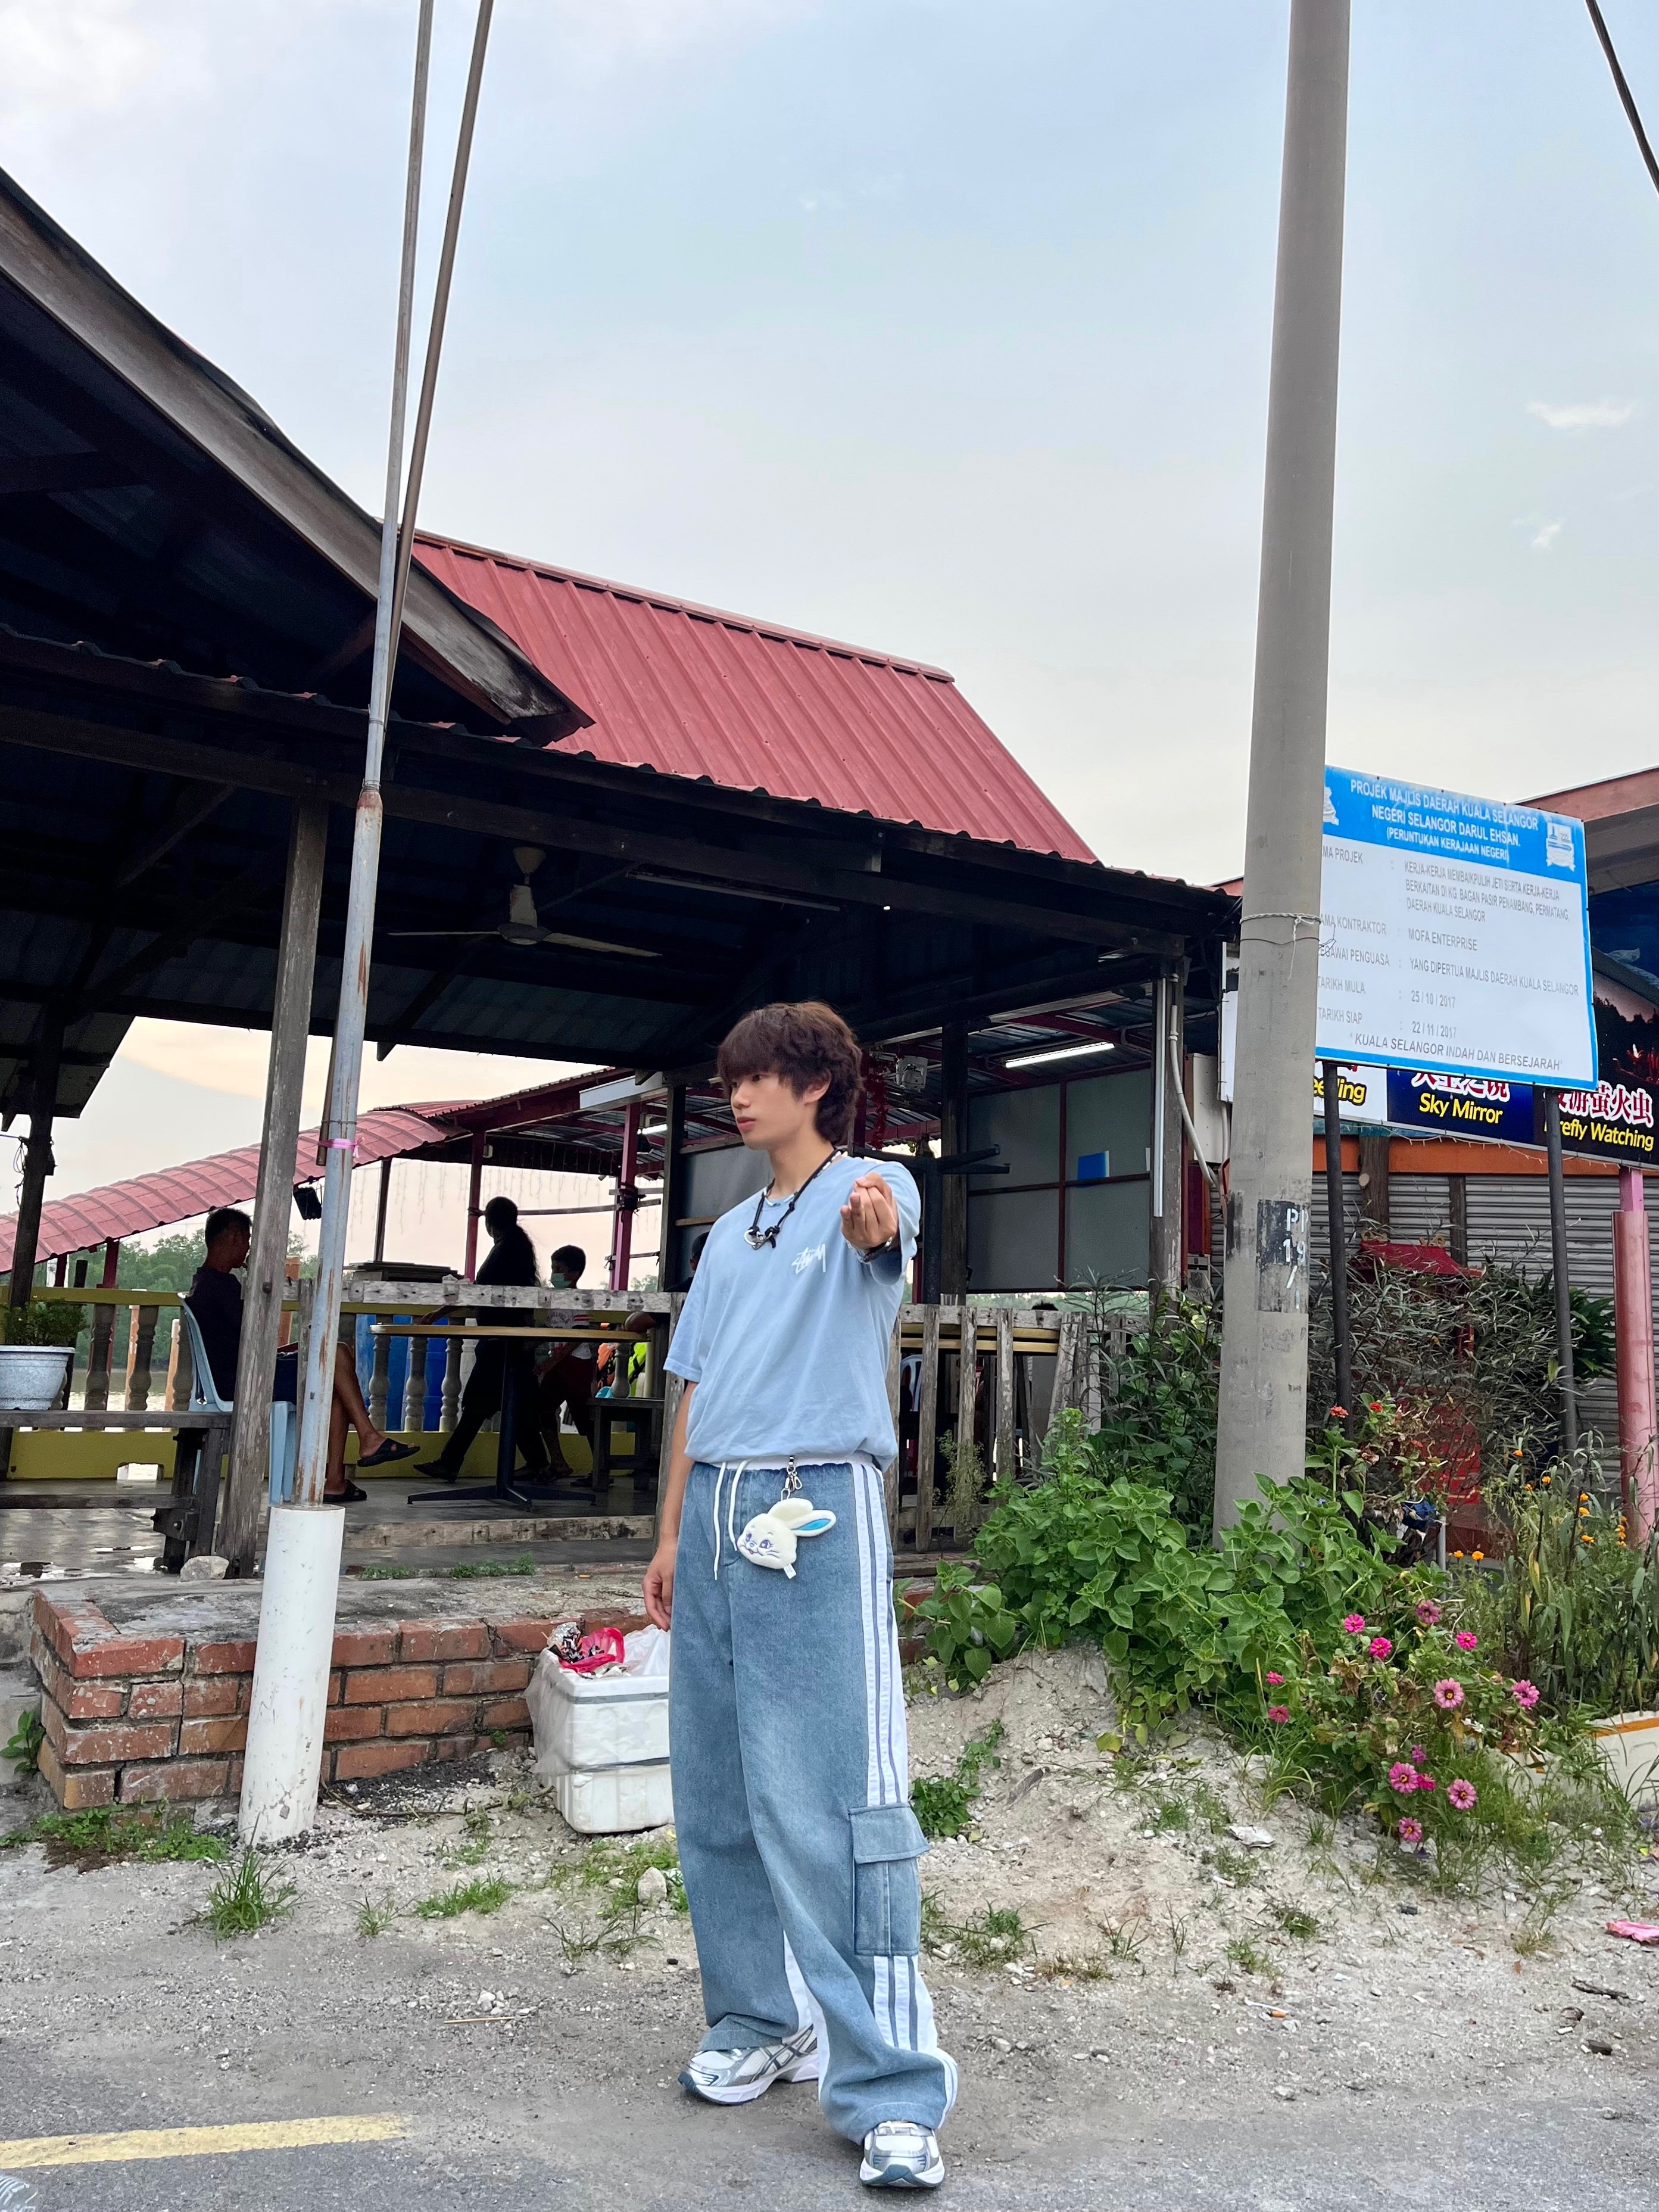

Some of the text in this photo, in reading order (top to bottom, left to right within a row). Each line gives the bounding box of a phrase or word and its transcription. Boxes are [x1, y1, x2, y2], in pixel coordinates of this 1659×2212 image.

[1351, 779, 1539, 831] PROJEK MAJLIS DAERAH KUALA SELANGOR
[1372, 804, 1521, 847] NEGERI SELANGOR DARUL EHSAN.
[1387, 827, 1509, 861] (PERUNTUKAN KERAJAAN NEGERI)
[1321, 846, 1334, 859] MA
[1335, 848, 1363, 864] PROJEK
[1405, 861, 1446, 878] KERJA-KERJA
[1448, 868, 1490, 888] MEMBAIKPULIH
[1492, 877, 1504, 889] JETI
[1504, 880, 1522, 894] SERTA
[1523, 883, 1560, 901] KERJA-KERJA
[1406, 879, 1570, 923] BERKAITAN DI KG. BAGAN PASIR PENAMBANG, PERMATANG,
[1407, 897, 1486, 923] DAERAH KUALA SELANGOR
[1337, 916, 1387, 935] KONTRAKTOR
[1408, 927, 1430, 943] MOFA
[1432, 931, 1477, 951] ENTERPRISE
[1345, 979, 1366, 994] MULA
[1350, 949, 1390, 967] PENGUASA
[1409, 957, 1429, 972] YANG
[1430, 961, 1464, 978] DIPERTUA
[1465, 967, 1489, 982] MAJLIS
[1490, 971, 1518, 987] DAERAH
[1519, 976, 1542, 990] KUALA
[1543, 980, 1579, 996] SELANGOR
[1318, 1007, 1345, 1022] TARIKH
[1346, 1010, 1362, 1024] SIAP
[1355, 1033, 1388, 1049] KUALA
[1390, 1038, 1443, 1056] SELANGOR
[1446, 1045, 1474, 1060] INDAH
[1477, 1049, 1496, 1063] DAN
[1419, 1092, 1503, 1124] Sky Mirror
[1591, 1122, 1654, 1151] Watching
